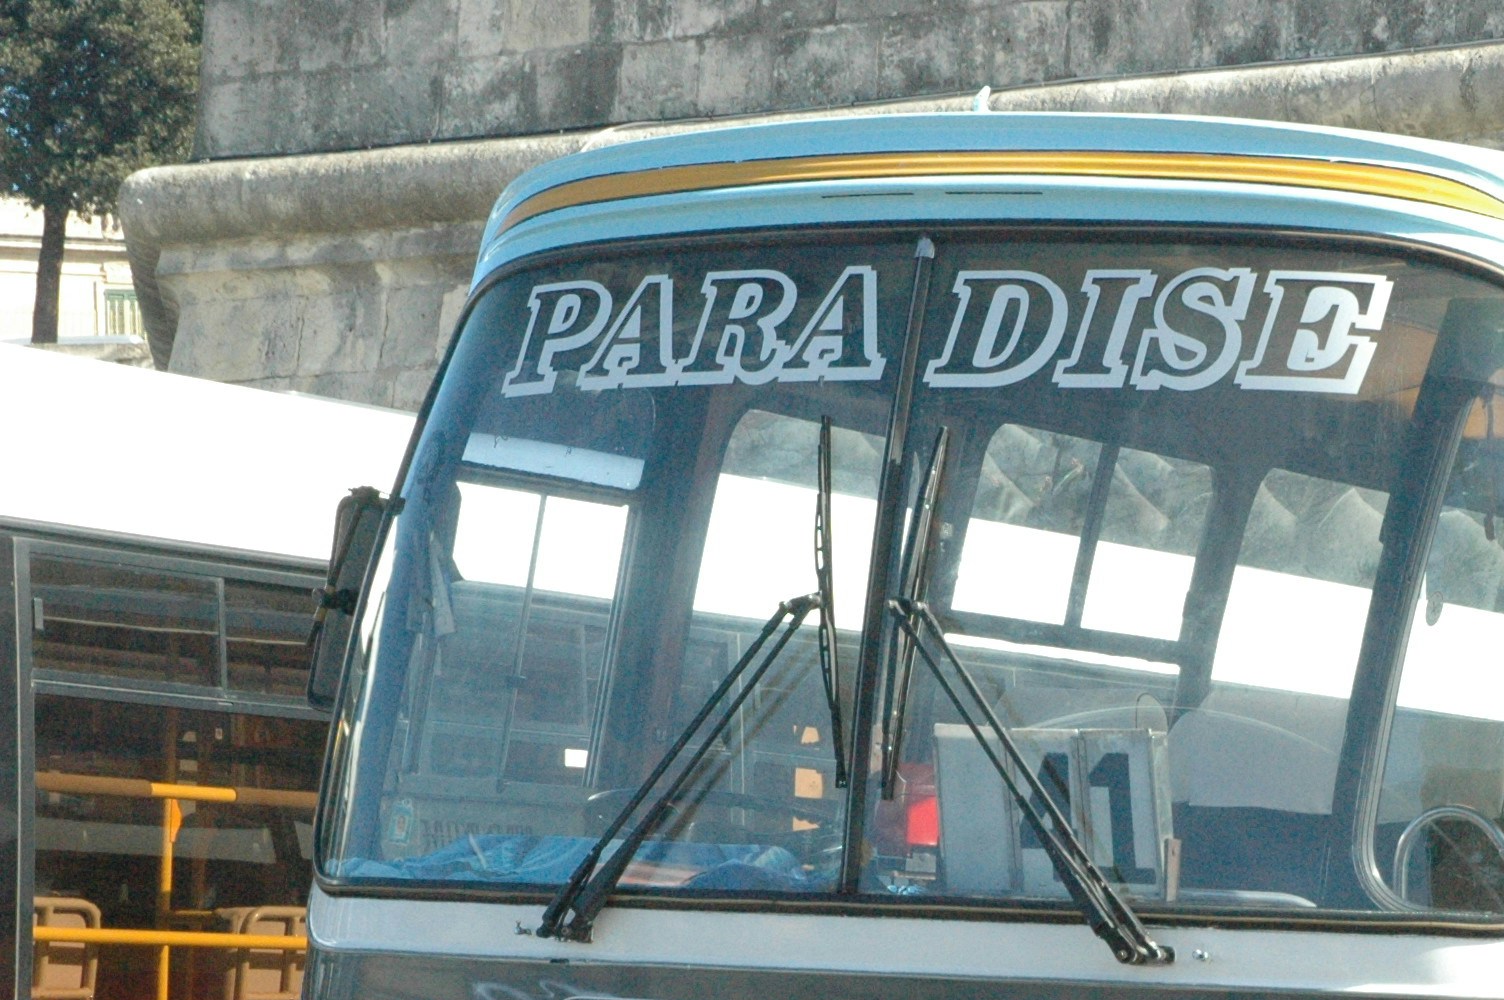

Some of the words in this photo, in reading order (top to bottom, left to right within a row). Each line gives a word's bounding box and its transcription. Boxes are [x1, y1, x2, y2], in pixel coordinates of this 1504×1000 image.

[503, 266, 886, 397] PARA
[924, 267, 1394, 395] DISE
[1020, 752, 1157, 885] 41
